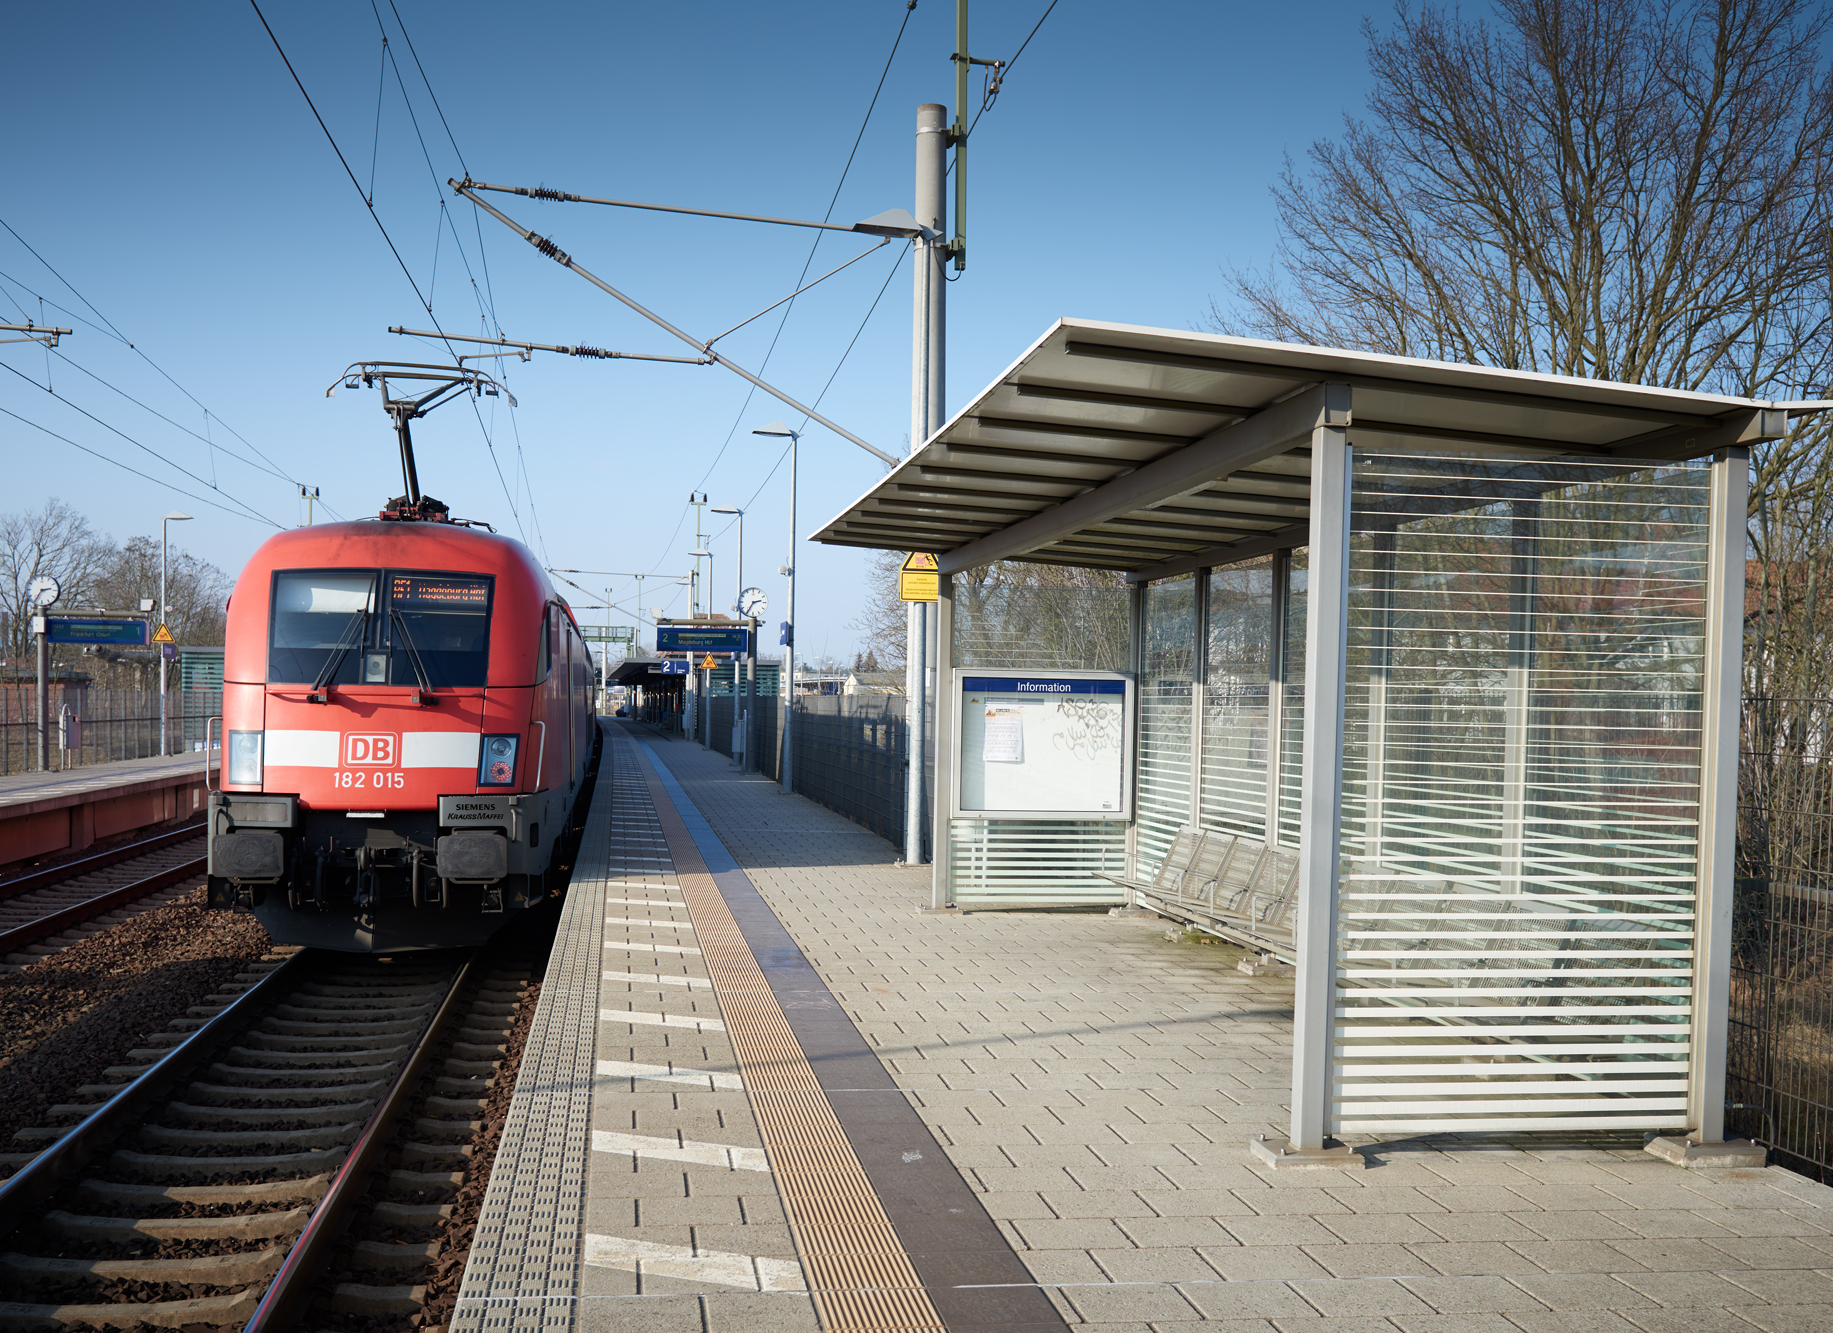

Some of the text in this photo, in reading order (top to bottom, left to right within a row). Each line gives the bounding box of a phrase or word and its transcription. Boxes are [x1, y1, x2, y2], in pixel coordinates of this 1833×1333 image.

[662, 633, 668, 643] 2
[663, 660, 670, 672] 2
[1017, 681, 1071, 692] Information
[350, 737, 391, 762] DB
[333, 771, 404, 789] 182 015
[455, 803, 496, 811] SIEMENS
